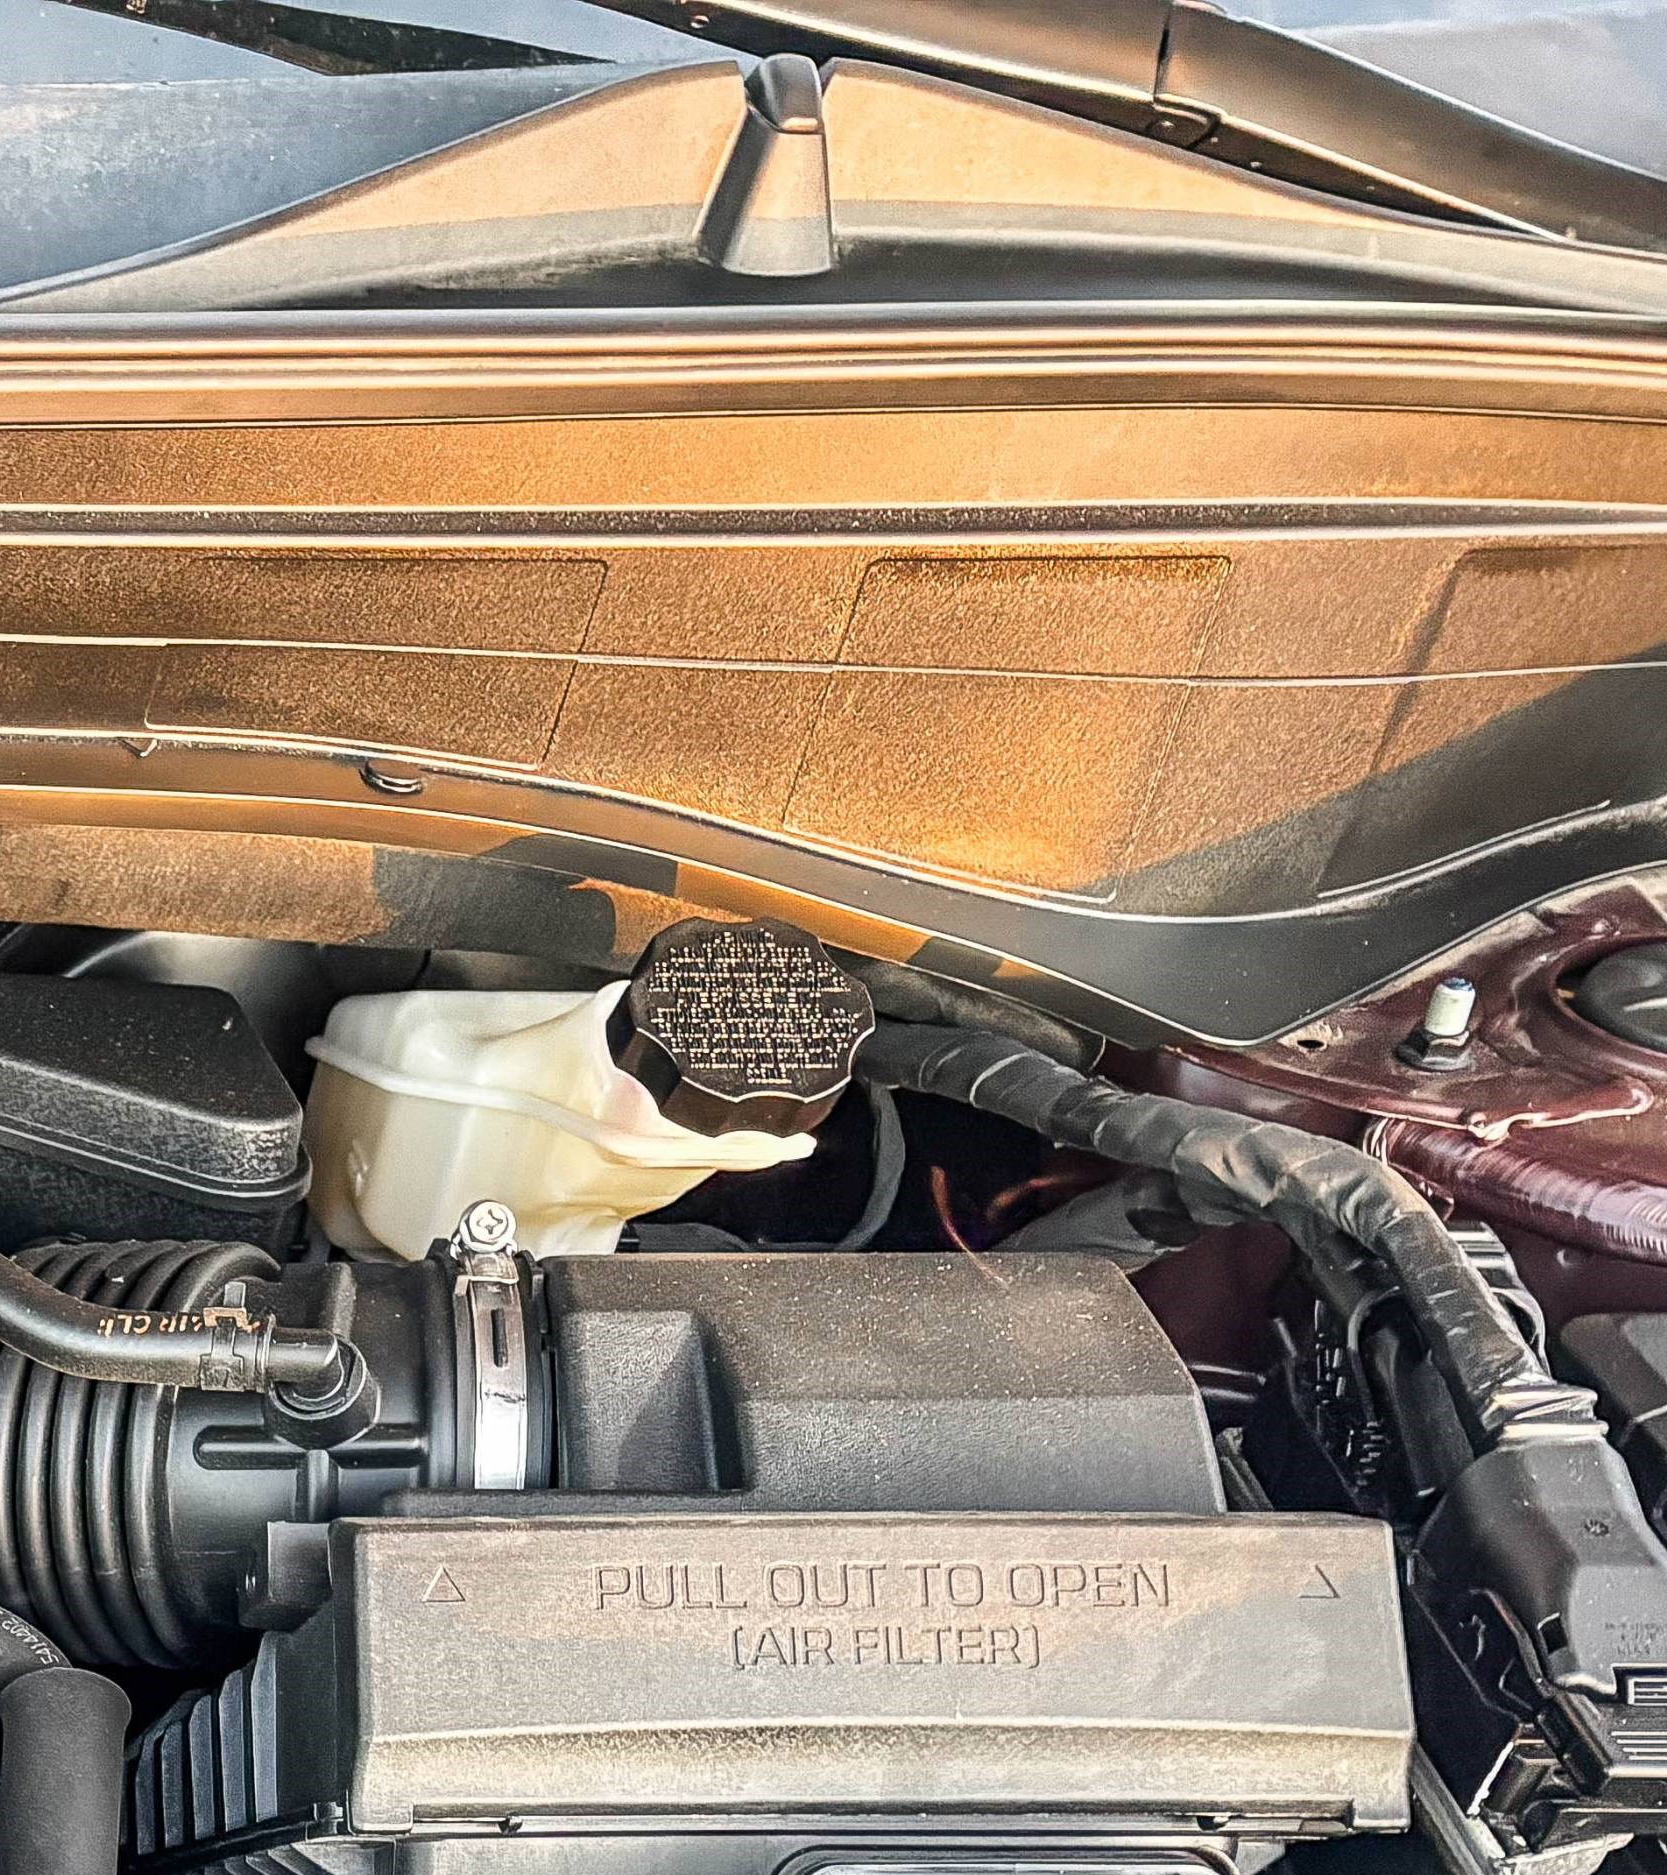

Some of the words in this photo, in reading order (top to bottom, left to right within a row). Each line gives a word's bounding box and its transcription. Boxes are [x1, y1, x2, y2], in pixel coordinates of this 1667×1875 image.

[592, 1562, 749, 1611] PULL
[768, 1562, 888, 1609] OUT
[903, 1562, 985, 1609] TO
[1008, 1562, 1171, 1609] OPEN
[732, 1624, 835, 1670] (AIR
[853, 1624, 1041, 1670] FILTER)
